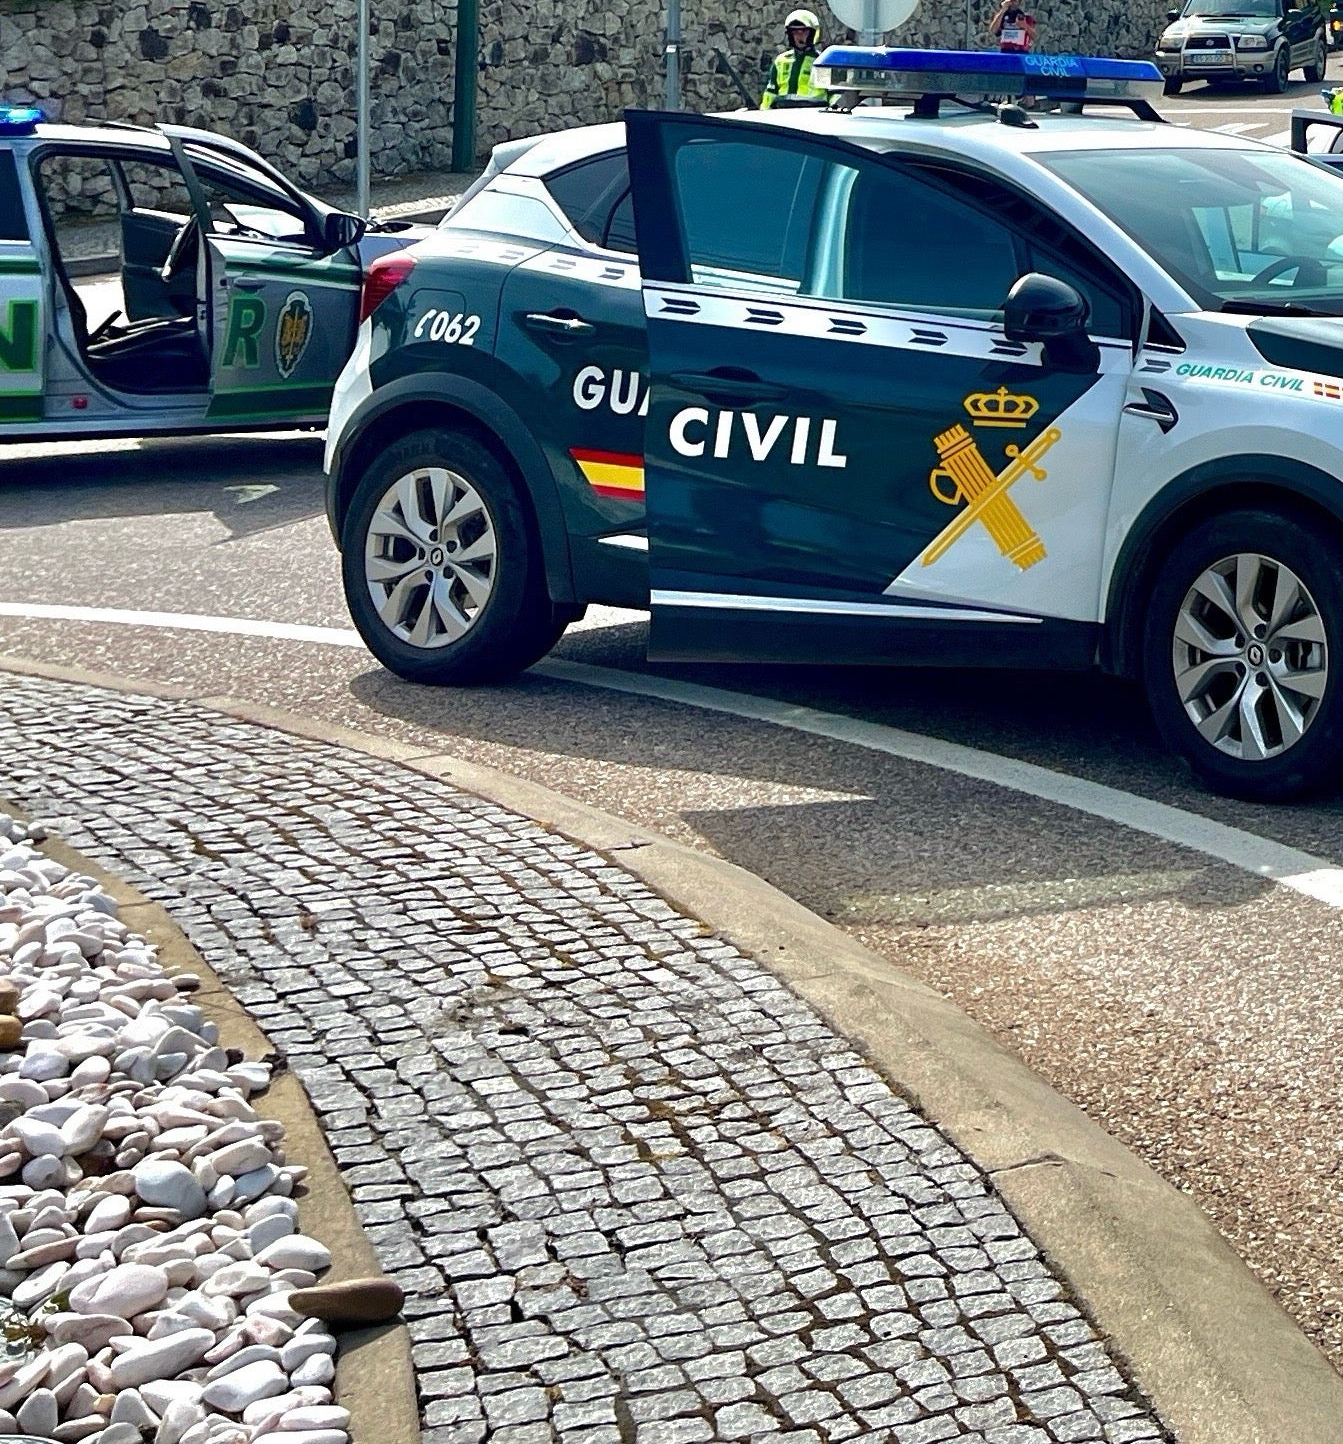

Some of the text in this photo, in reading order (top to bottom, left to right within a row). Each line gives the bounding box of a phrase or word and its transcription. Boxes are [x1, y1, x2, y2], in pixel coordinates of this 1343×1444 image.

[1024, 56, 1078, 67] GUARDIA
[1040, 66, 1071, 77] CIVIL
[429, 311, 481, 345] 062
[1176, 363, 1305, 391] GUARDIA CIVIL
[668, 406, 848, 469] CIVIL
